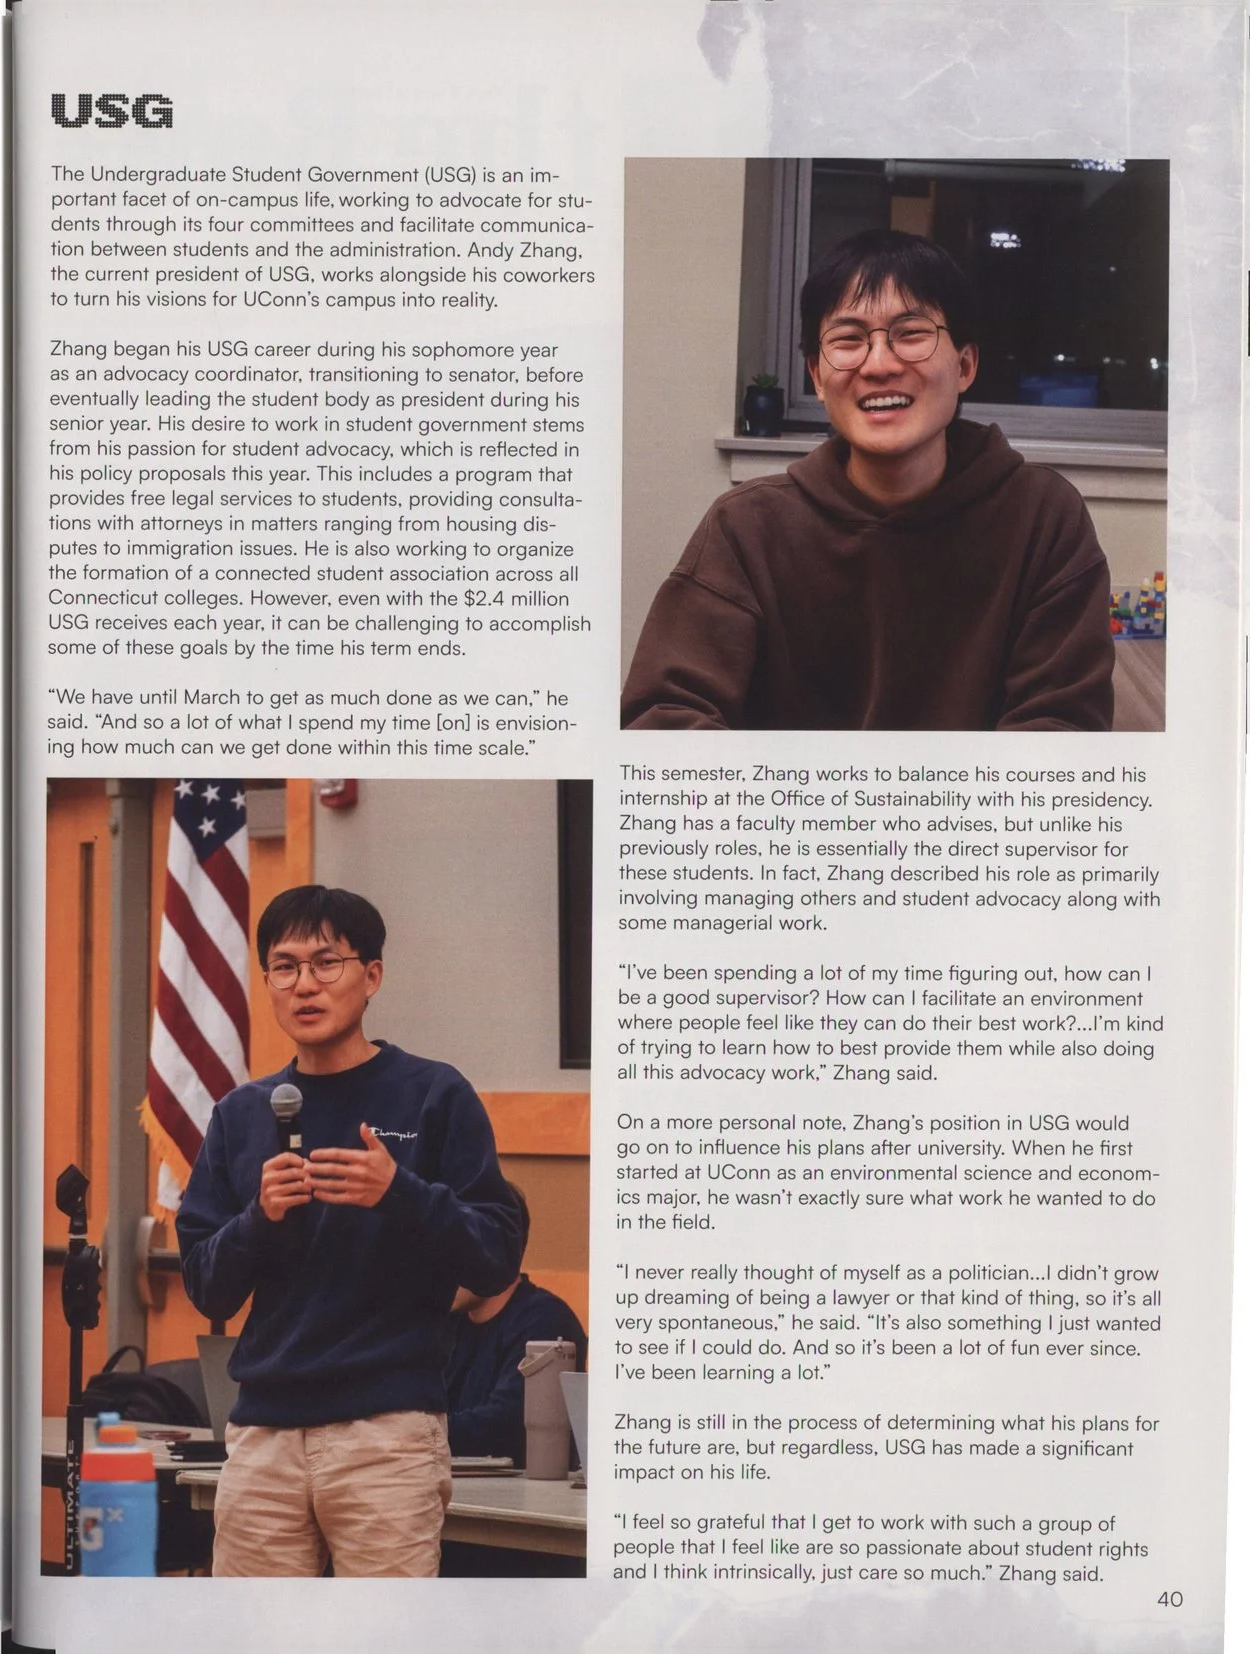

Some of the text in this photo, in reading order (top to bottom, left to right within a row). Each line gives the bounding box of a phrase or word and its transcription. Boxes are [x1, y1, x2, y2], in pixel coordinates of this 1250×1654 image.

[50, 92, 174, 129] USG
[50, 164, 560, 187] The Undergraduate Student Government (USG) is an im-
[50, 214, 595, 237] dents through its four committees and facilitate communica-
[49, 364, 584, 387] as an advocacy coordinator, transitioning to senator, before
[49, 488, 583, 512] provides free legal services to students, providing consulta-
[48, 587, 570, 610] Connecticut colleges. However, even with the $2.4 million
[619, 788, 1153, 812] internship at the Office of Sustainability with his presidency.
[619, 888, 1161, 912] involving managing others and student advocacy along with
[618, 913, 828, 935] some managerial work.
[368, 1126, 418, 1141] Champio
[616, 1162, 1161, 1182] started at UConn as an environmental science and econom-
[613, 1437, 1135, 1461] the future are, but regardless, USG has made a significant
[614, 1463, 771, 1484] impact on his life.
[66, 1439, 75, 1570] ULTIMATE
[1157, 1590, 1184, 1608] 40
